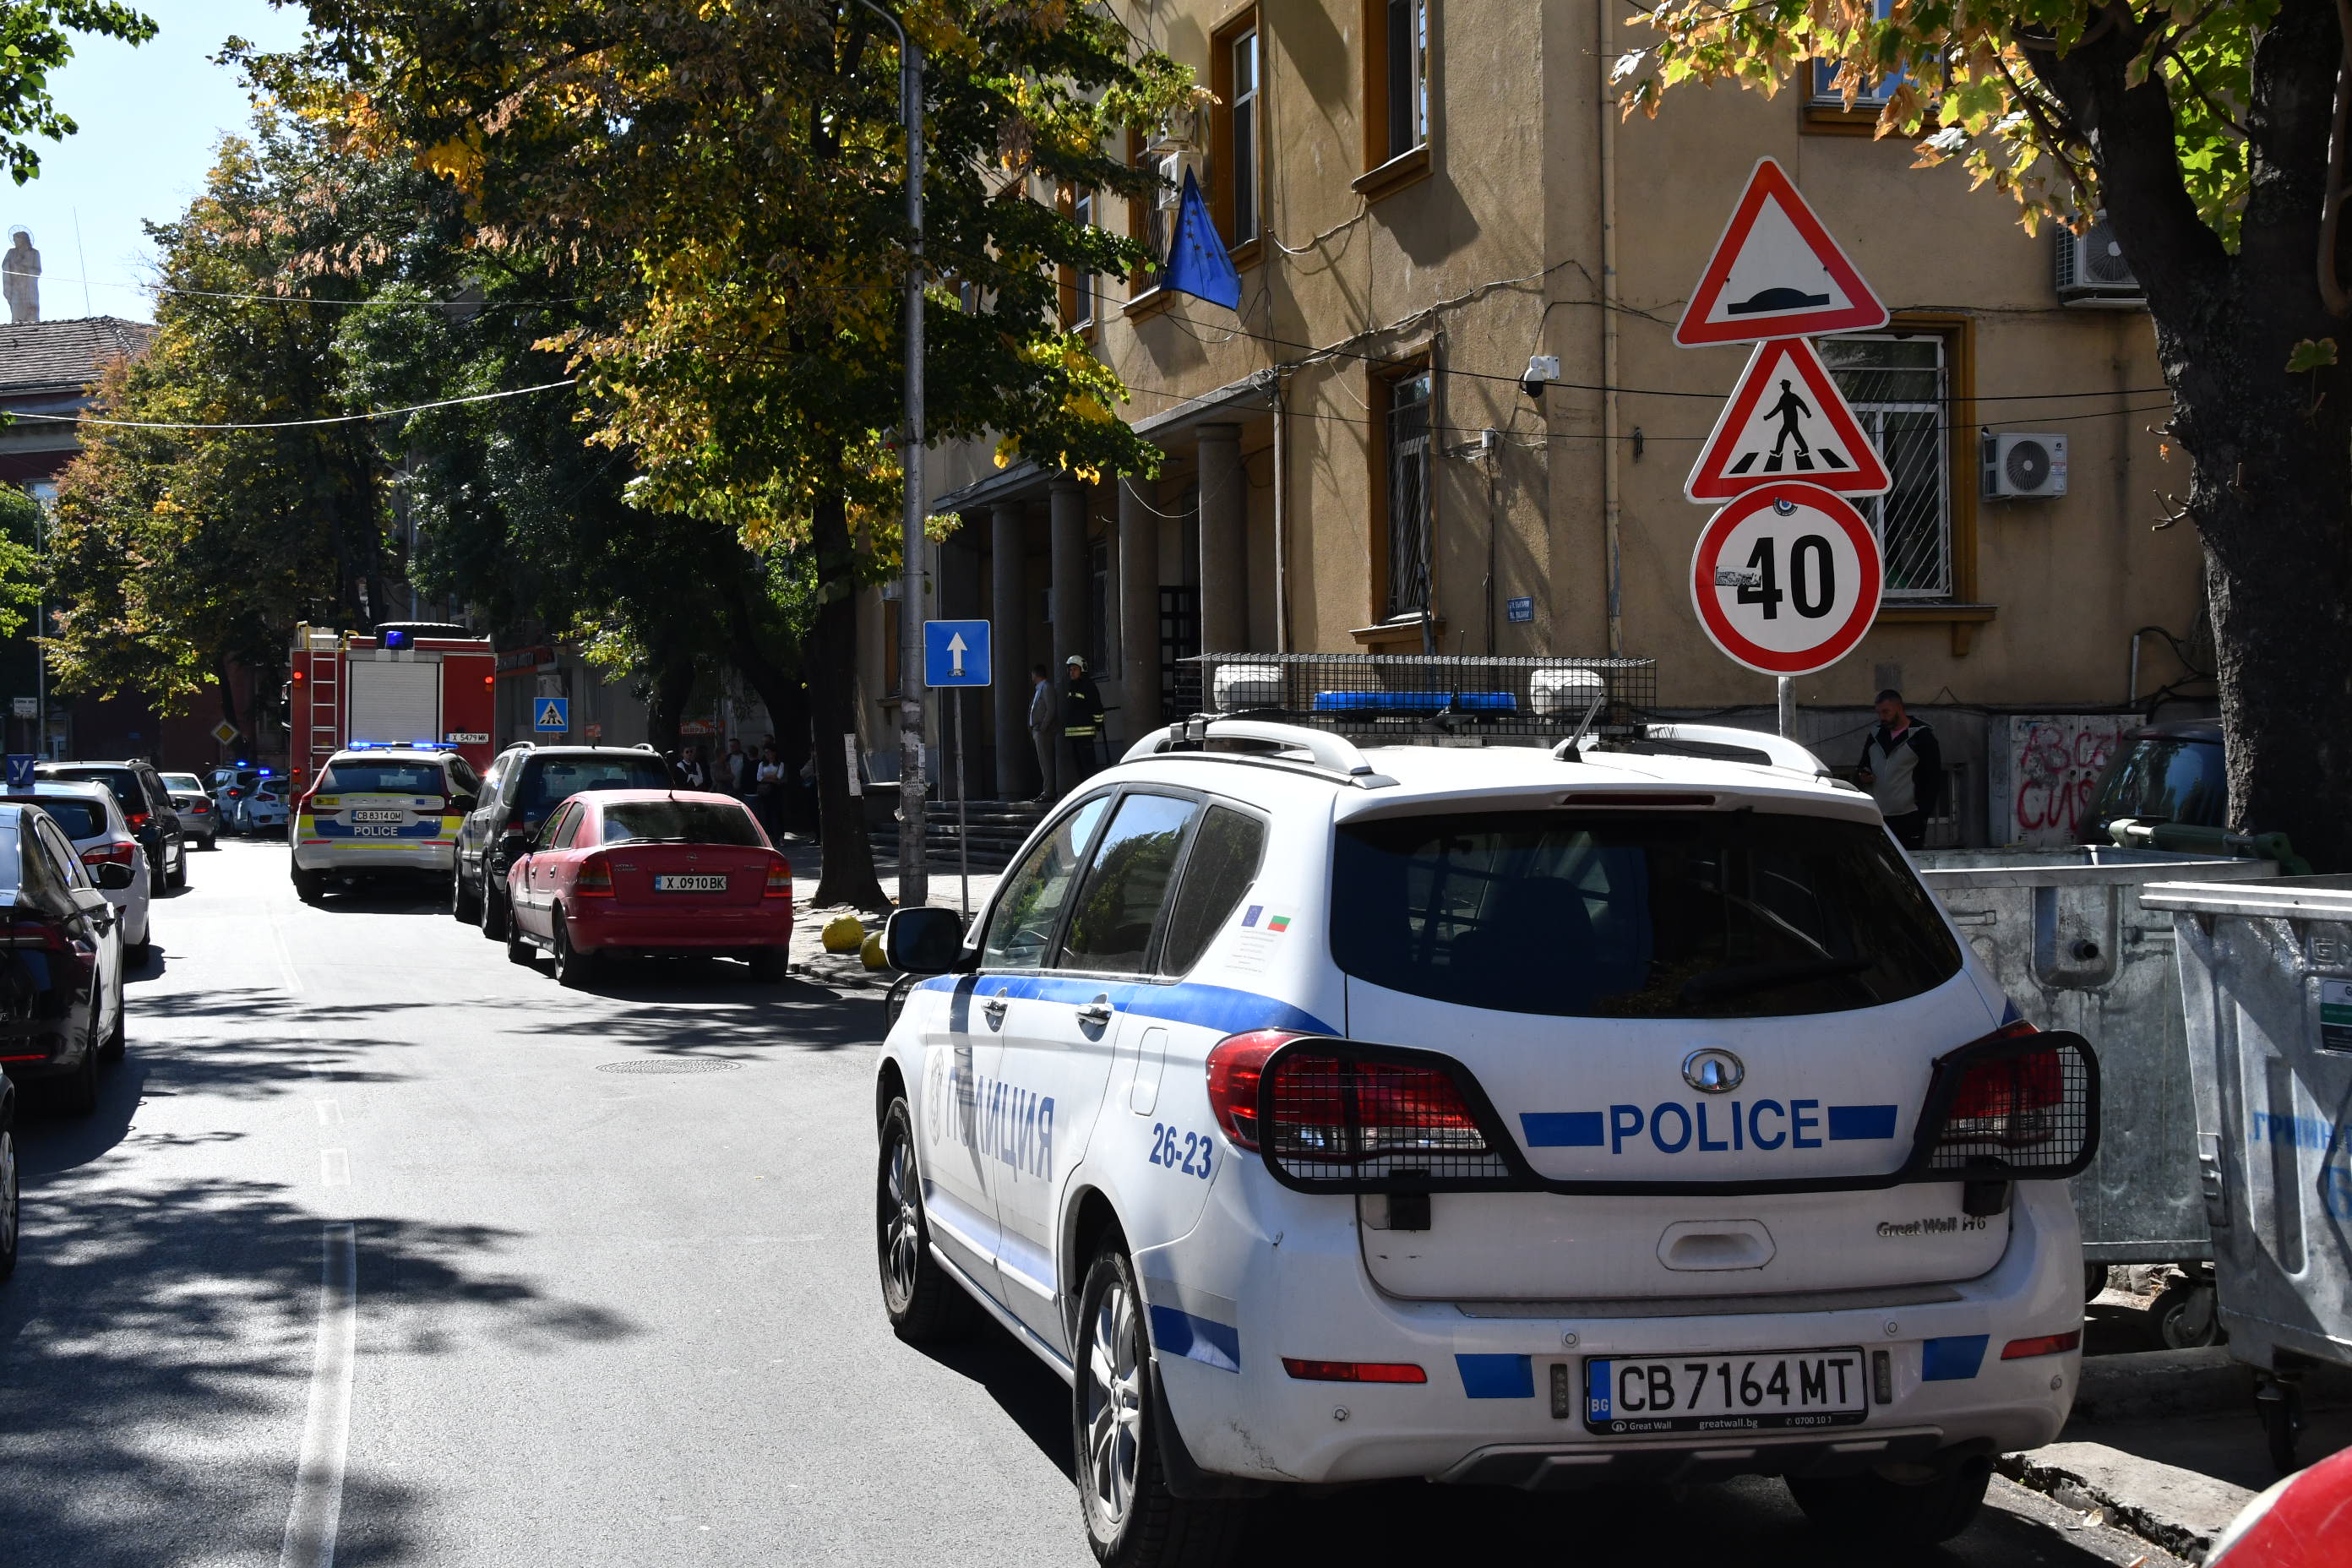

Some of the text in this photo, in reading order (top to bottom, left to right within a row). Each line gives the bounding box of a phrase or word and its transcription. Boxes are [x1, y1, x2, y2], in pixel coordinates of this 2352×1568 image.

[1737, 535, 1835, 620] 40
[354, 827, 398, 836] POLICE
[1610, 1099, 1821, 1154] POLICE
[1149, 1123, 1212, 1179] 26-23
[1877, 1221, 1920, 1237] Great
[1923, 1217, 1957, 1234] Wall
[1619, 1358, 1854, 1411] CB 7164 MT
[1591, 1398, 1609, 1413] BG
[1630, 1421, 1672, 1430] Great Wall
[1699, 1418, 1758, 1430] greatwall.bg
[1795, 1417, 1815, 1425] 0700
